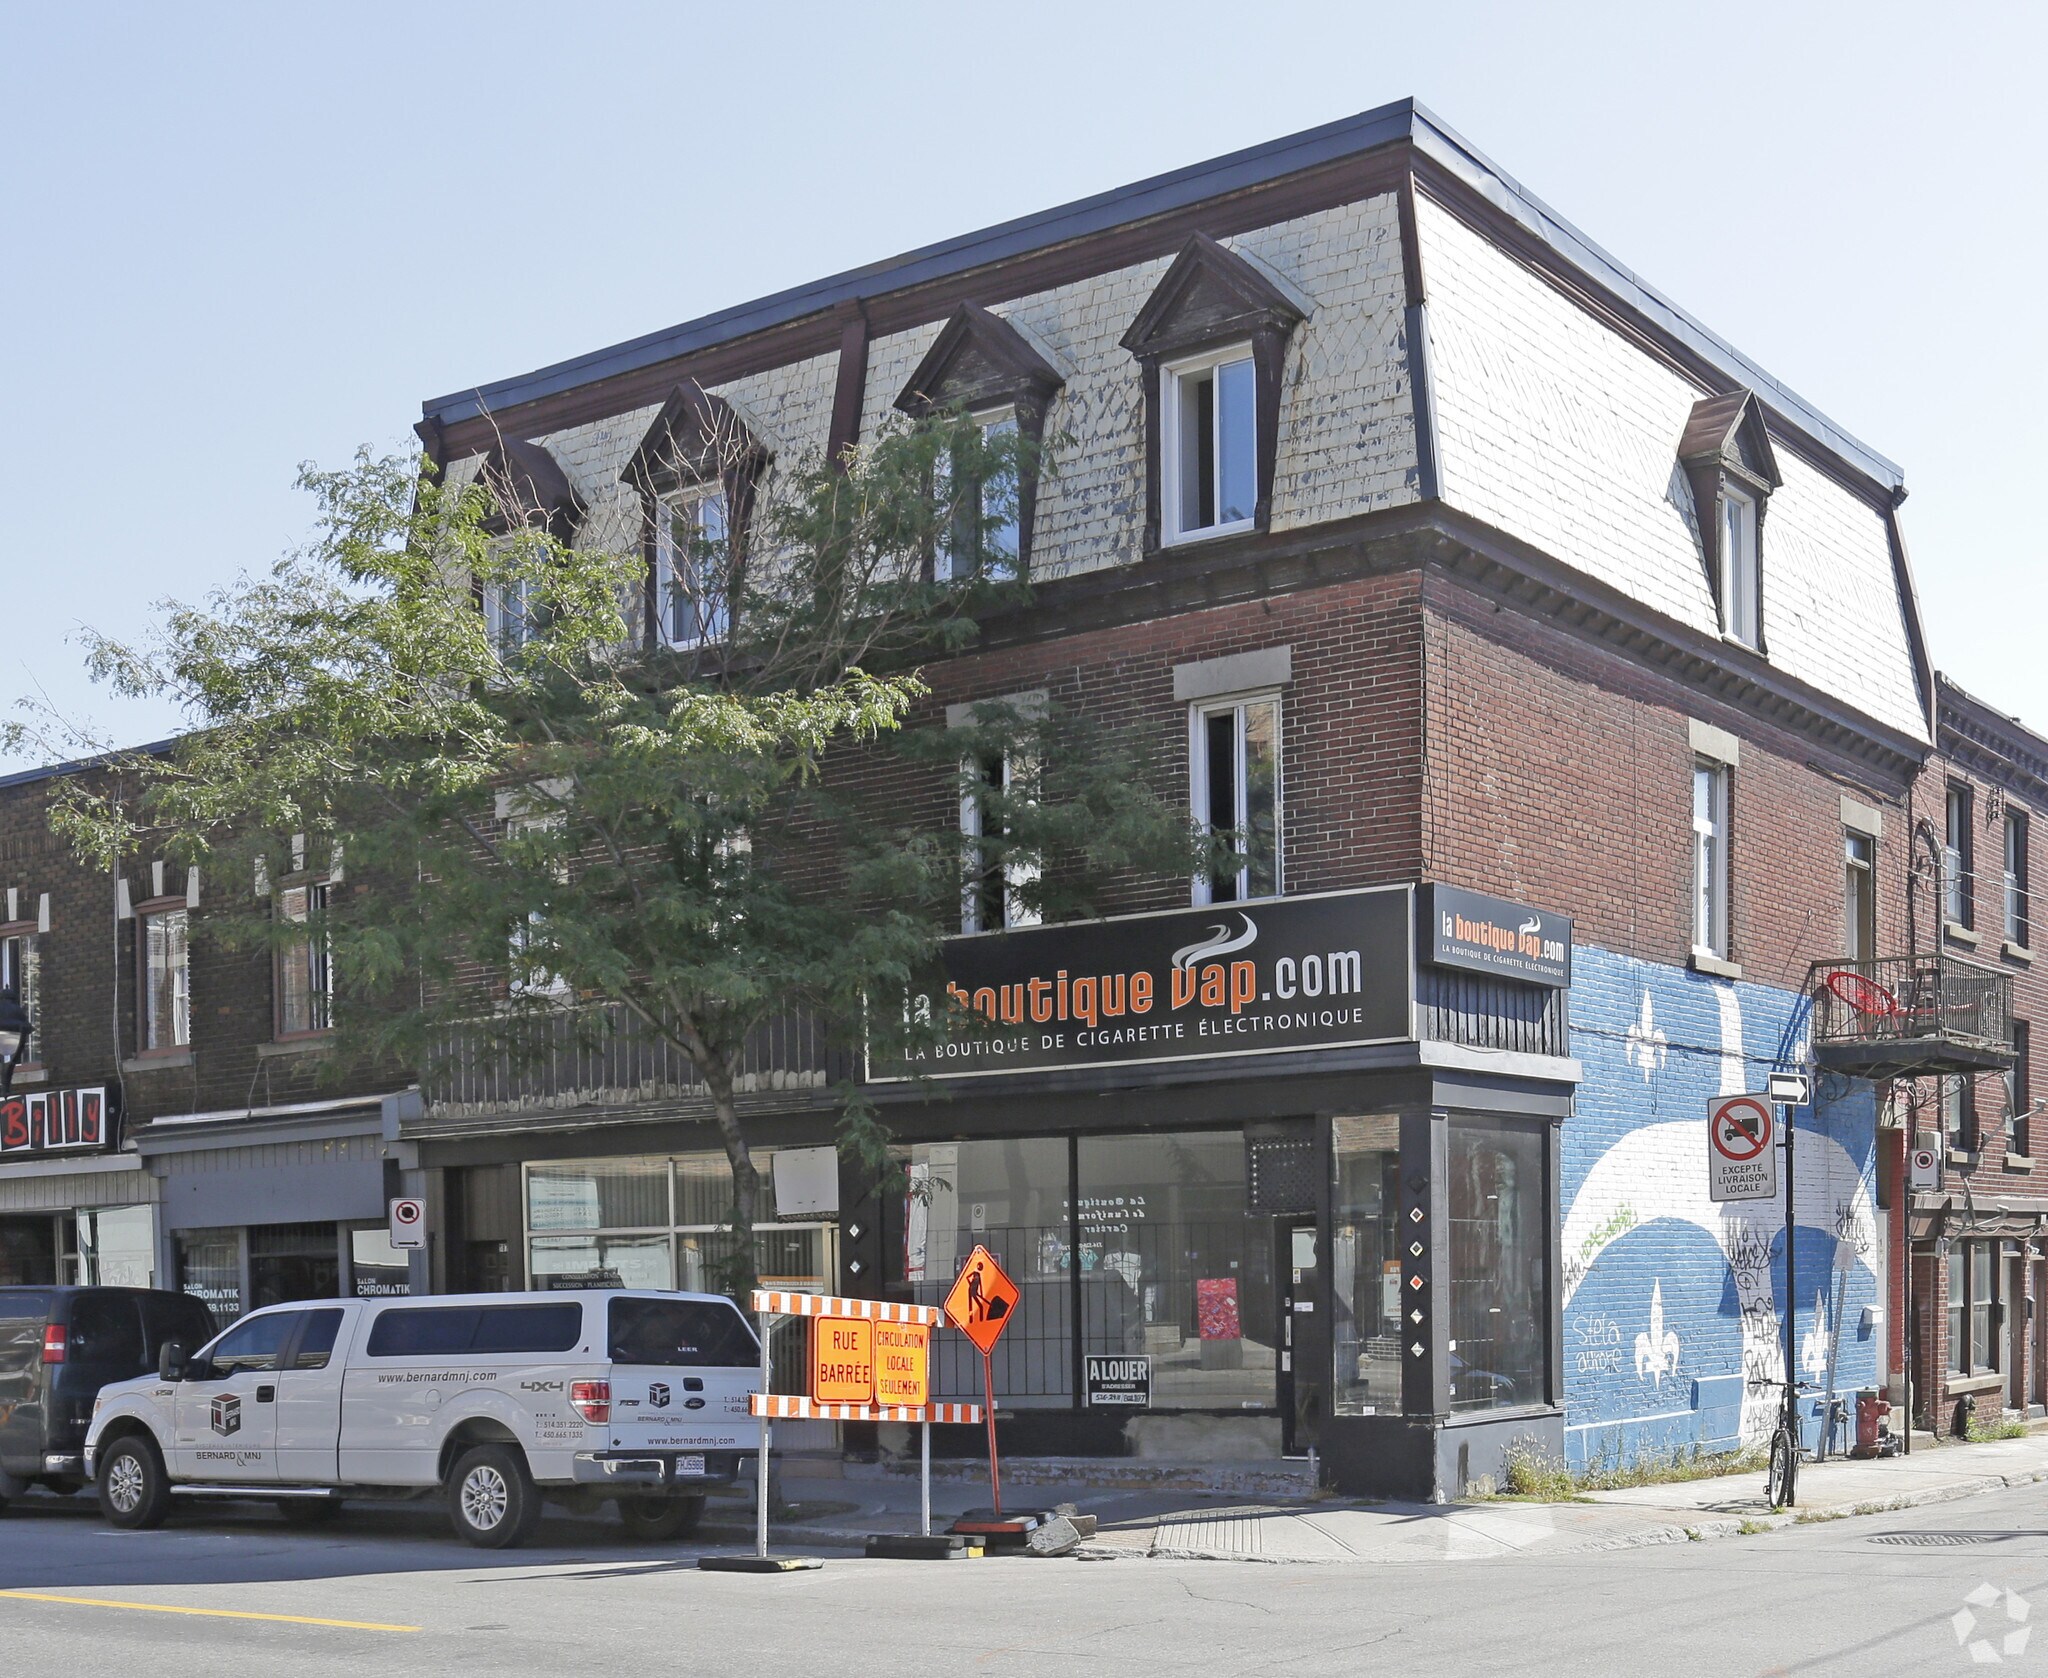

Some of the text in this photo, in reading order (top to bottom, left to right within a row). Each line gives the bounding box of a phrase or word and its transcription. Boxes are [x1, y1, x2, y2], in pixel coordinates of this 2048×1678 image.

[1442, 910, 1453, 938] la
[1455, 913, 1515, 952] boutique
[1442, 944, 1564, 977] LA BOUTIQUE DE CIGARETTE ÉLECTRONIQUE
[905, 1007, 1364, 1061] LA BOUTIQUE DE CIGARETTE ÉLECTRONIQUE
[0, 1096, 101, 1146] Billy
[1718, 1173, 1768, 1185] LIVRAISON
[1725, 1183, 1761, 1194] LOCALE
[357, 1284, 411, 1295] CHROMATIK
[833, 1331, 858, 1350] RUE
[877, 1331, 924, 1348] CIRCULATION
[887, 1356, 914, 1371] LOCALE
[1101, 1360, 1148, 1381] LOUER
[378, 1371, 497, 1383] www.bernardmnj.com
[820, 1361, 870, 1383] BARRÉE
[880, 1379, 921, 1395] SEULEMENT
[648, 1437, 736, 1446] www.bernardmnj.com
[196, 1451, 236, 1460] BERNARD
[244, 1451, 262, 1460] MNJ
